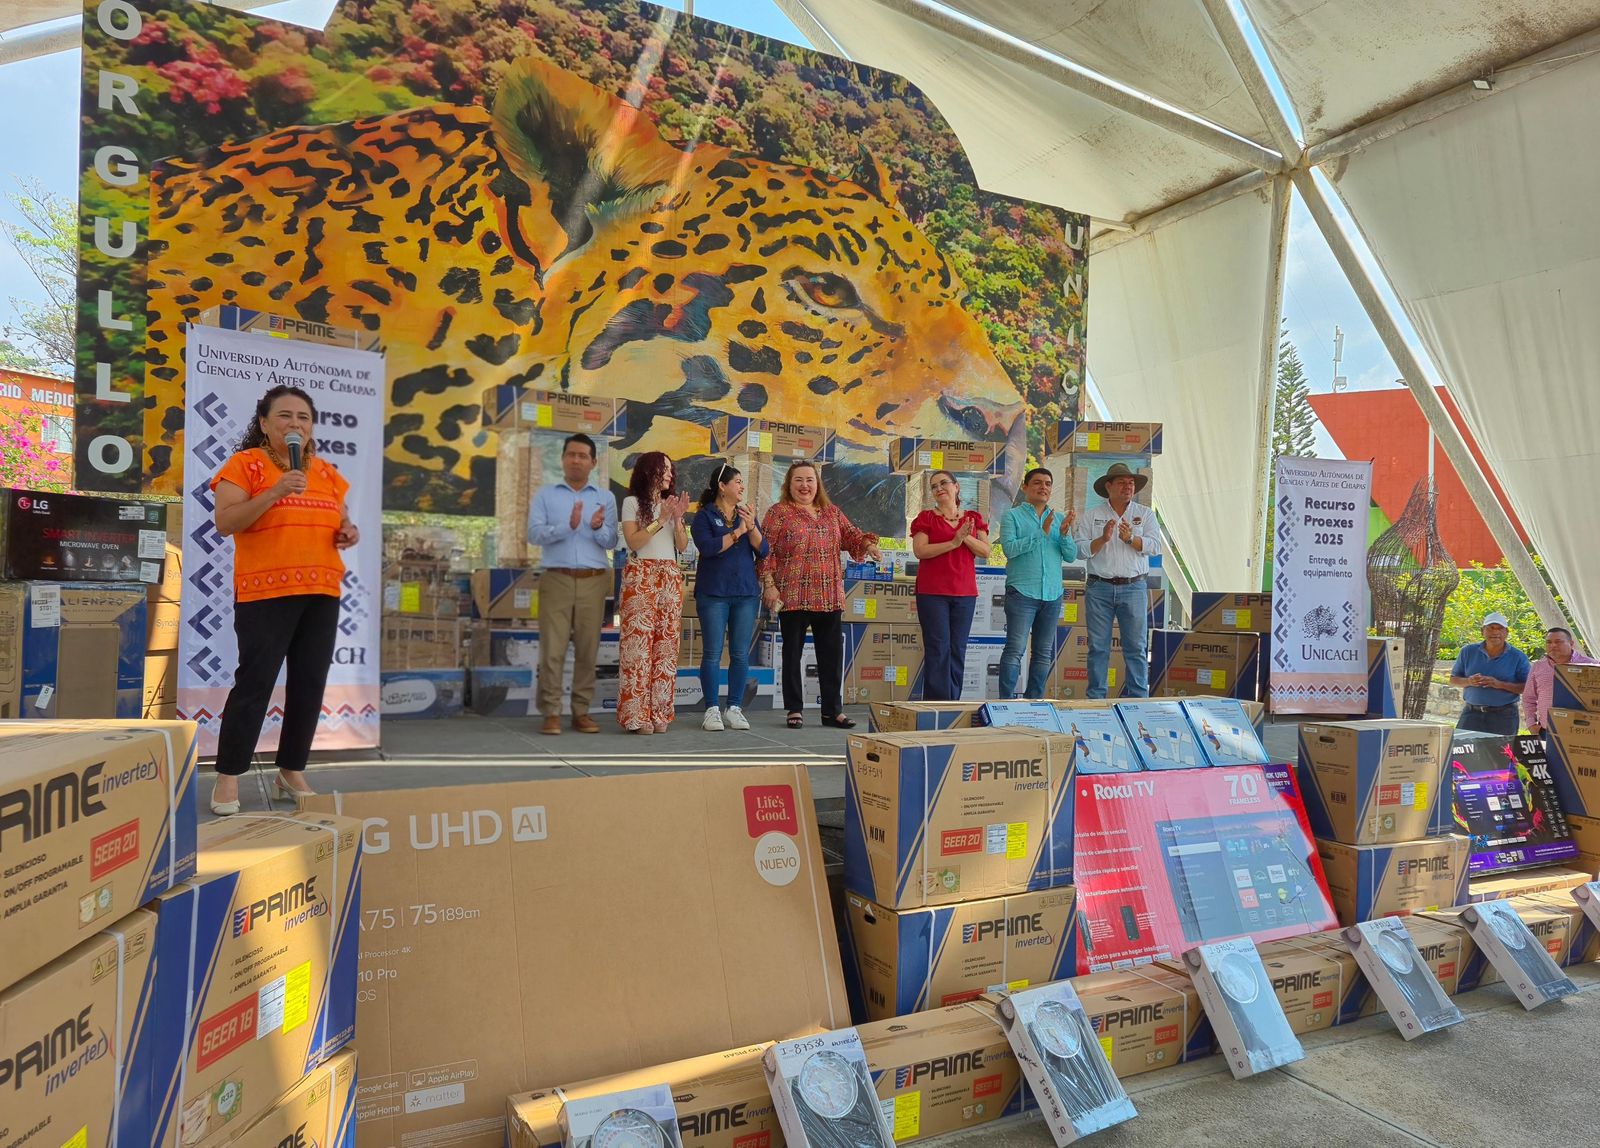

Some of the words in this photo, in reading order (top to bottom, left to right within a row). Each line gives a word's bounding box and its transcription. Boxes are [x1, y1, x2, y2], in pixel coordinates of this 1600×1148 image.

[283, 318, 336, 339] PRIME
[547, 392, 591, 407] PRIME
[768, 421, 804, 435] PRIME
[1095, 422, 1131, 432] PRIME
[939, 440, 974, 451] PRIME
[33, 500, 48, 510] LG
[1305, 497, 1355, 511] Recurso
[1304, 515, 1354, 528] Proexes
[42, 528, 80, 539] SMART
[1314, 533, 1344, 545] 2025
[60, 541, 99, 550] MICROWAVE
[1309, 555, 1336, 566] Entrega
[1338, 556, 1348, 565] de
[1303, 568, 1353, 579] equipamiento
[874, 583, 916, 597] PRIME
[881, 633, 917, 644] PRIME
[1192, 643, 1229, 653] PRIME
[1396, 743, 1430, 757] PRIME
[1464, 744, 1474, 753] TV
[1520, 740, 1539, 754] 50"
[978, 758, 1042, 781] PRIME
[1532, 764, 1551, 780] 4K
[1578, 766, 1597, 778] NOM
[1014, 781, 1048, 791] inverter
[1136, 781, 1154, 797] TV
[0, 761, 107, 848] RIME
[102, 760, 154, 794] inverter
[756, 795, 784, 808] Life's
[1229, 797, 1261, 805] FRAMELESS
[756, 808, 790, 822] Good.
[409, 810, 503, 850] UHD
[516, 811, 543, 834] AI
[869, 826, 885, 843] NOM
[94, 839, 121, 867] SEER
[123, 830, 137, 852] 20
[943, 835, 967, 849] SEER
[968, 834, 981, 846] 20
[767, 845, 786, 854] 2025
[4, 854, 47, 879] SILENCIOSO
[760, 857, 797, 871] NUEVO
[1408, 856, 1449, 873] PRIME
[4, 879, 33, 899] ON/OFF
[34, 855, 84, 884] PROGRAMABLE
[4, 899, 32, 919] AMPLIA
[33, 881, 68, 904] GARANTIA
[250, 875, 317, 931] PRIME
[284, 902, 326, 932] inverter
[409, 904, 438, 925] 75
[439, 907, 481, 922] 189cm
[978, 912, 1044, 941] PRIME
[1015, 935, 1051, 948] inverter
[364, 948, 400, 960] Processor
[401, 946, 411, 954] 4K
[377, 968, 397, 980] Pro
[1273, 970, 1322, 993] PRIME
[1106, 1002, 1164, 1031] PRIME
[201, 1018, 237, 1057] SEER
[240, 1008, 254, 1034] 18
[45, 1038, 104, 1096] inverter
[912, 1049, 986, 1085] PRIME
[428, 1074, 450, 1084] Apple
[450, 1070, 475, 1080] AirPlay
[357, 1084, 381, 1094] Google
[383, 1081, 399, 1089] Cast
[220, 1090, 234, 1105] R32
[425, 1092, 460, 1103] matter
[377, 1105, 400, 1115] Home
[677, 1102, 748, 1140] RIME
